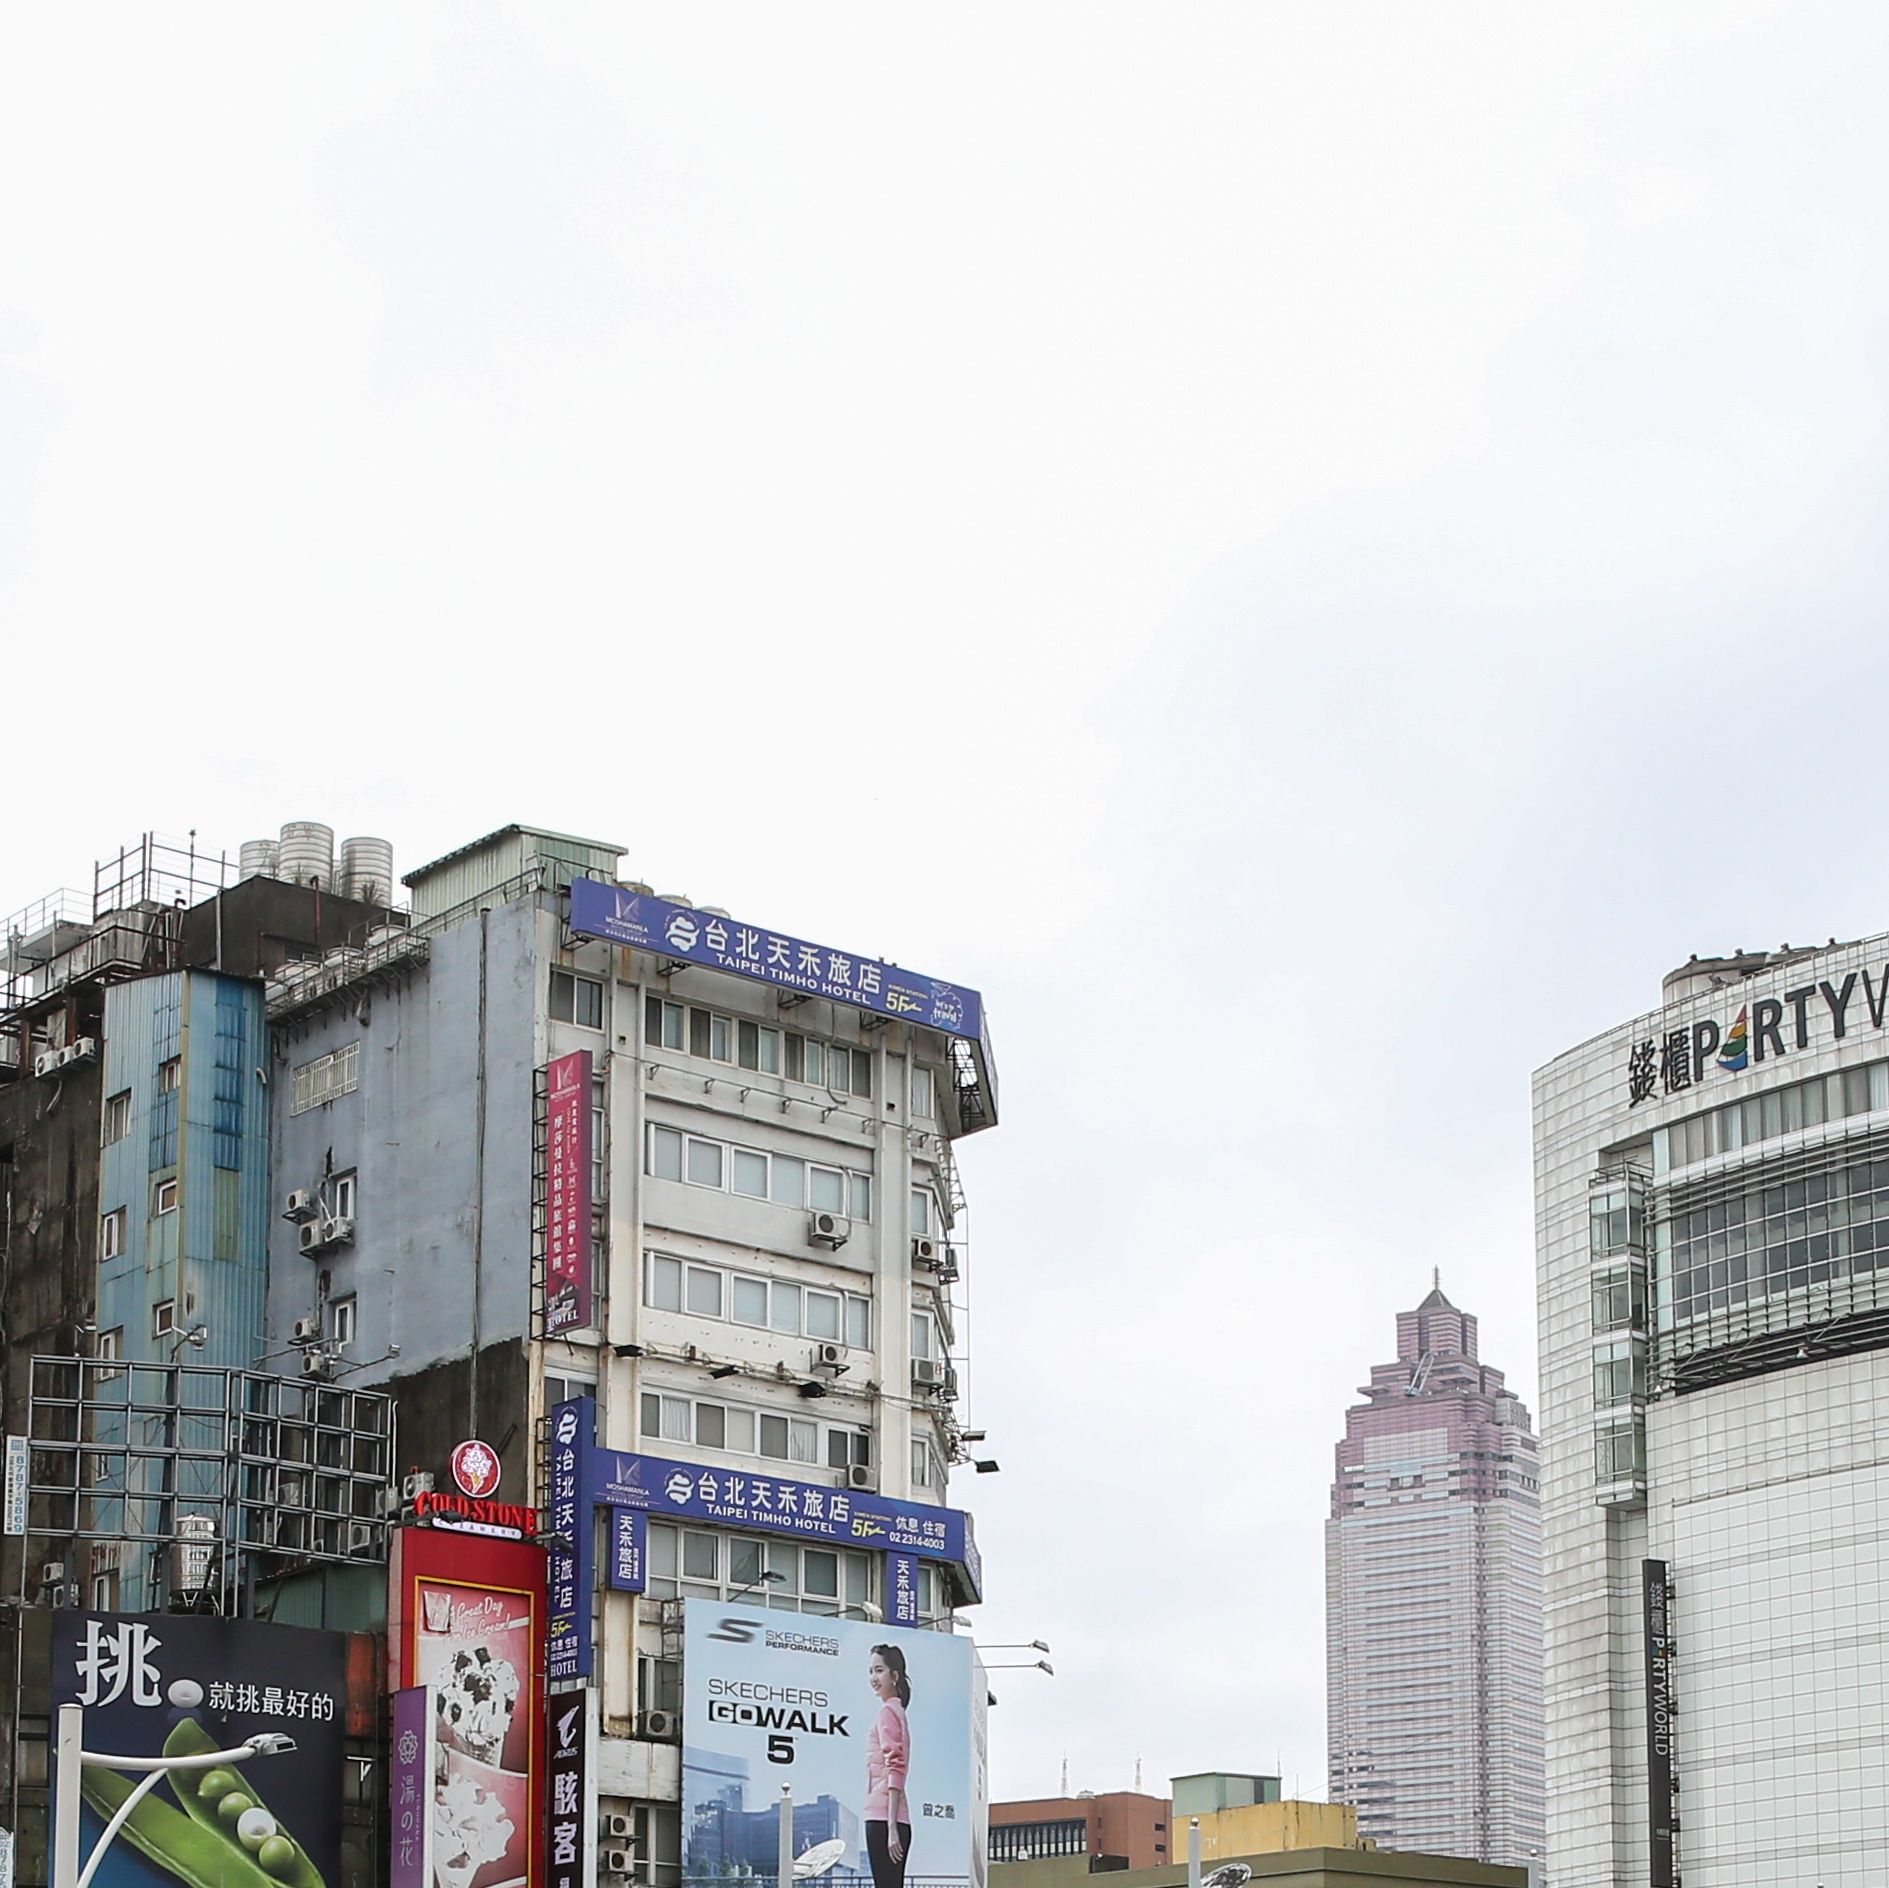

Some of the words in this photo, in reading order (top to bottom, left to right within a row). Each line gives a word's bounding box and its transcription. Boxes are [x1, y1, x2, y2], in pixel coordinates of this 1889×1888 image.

[705, 919, 882, 995] 台北天禾旅店
[717, 953, 765, 976] TAIPEI
[769, 968, 818, 990] TIMHO
[821, 982, 870, 1006] HOTEL
[1628, 1027, 1691, 1107] 錢櫃
[14, 1456, 25, 1532] 8787-5869
[415, 1490, 470, 1521] COLD
[473, 1501, 538, 1536] STONE
[698, 1470, 851, 1523] 台北天禾旅店
[707, 1503, 749, 1521] TAIPEI
[751, 1510, 792, 1528] TIMHO
[795, 1517, 836, 1534] HOTEL
[434, 1518, 521, 1539] CEAMERY
[560, 1448, 575, 1609] 台北天旅店
[618, 1514, 634, 1580] 天禾旅店
[889, 1531, 901, 1544] 02
[902, 1533, 945, 1550] 2314-4003
[895, 1516, 919, 1532] 休息
[922, 1520, 946, 1538] 住宿
[896, 1558, 910, 1621] 天禾旅店
[765, 1629, 839, 1649] SKECHERS
[765, 1640, 839, 1657] PERFORMANCE
[75, 1619, 163, 1710] 挑
[208, 1681, 335, 1723] 就挑最好的
[550, 1659, 577, 1677] HOTEL
[708, 1678, 829, 1708] SKECHERS
[767, 1734, 795, 1764] 5
[397, 1774, 415, 1869] 湯の花
[552, 1774, 579, 1868] 駭客
[922, 1802, 955, 1820] 曾之喬
